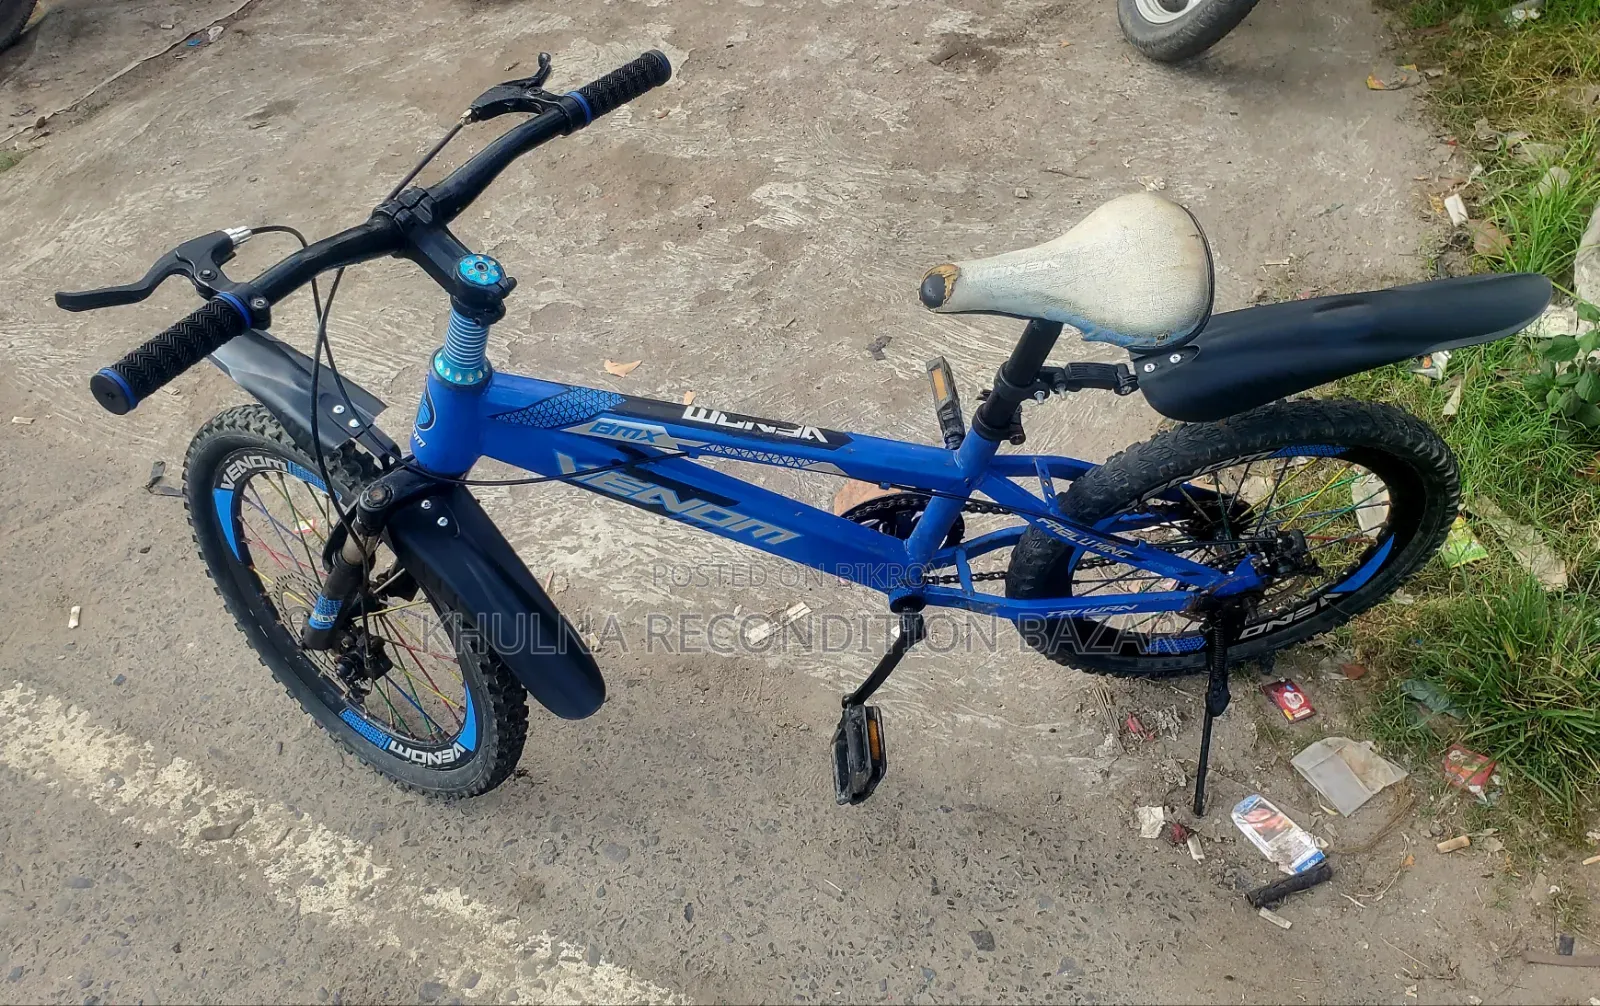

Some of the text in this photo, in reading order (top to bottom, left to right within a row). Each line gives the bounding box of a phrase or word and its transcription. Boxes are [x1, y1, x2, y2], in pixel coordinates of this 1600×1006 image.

[589, 422, 665, 443] BMX
[682, 406, 828, 443] VENOM
[220, 455, 288, 490] VENOM
[555, 452, 802, 545] VENOM
[388, 741, 466, 766] VENOM
